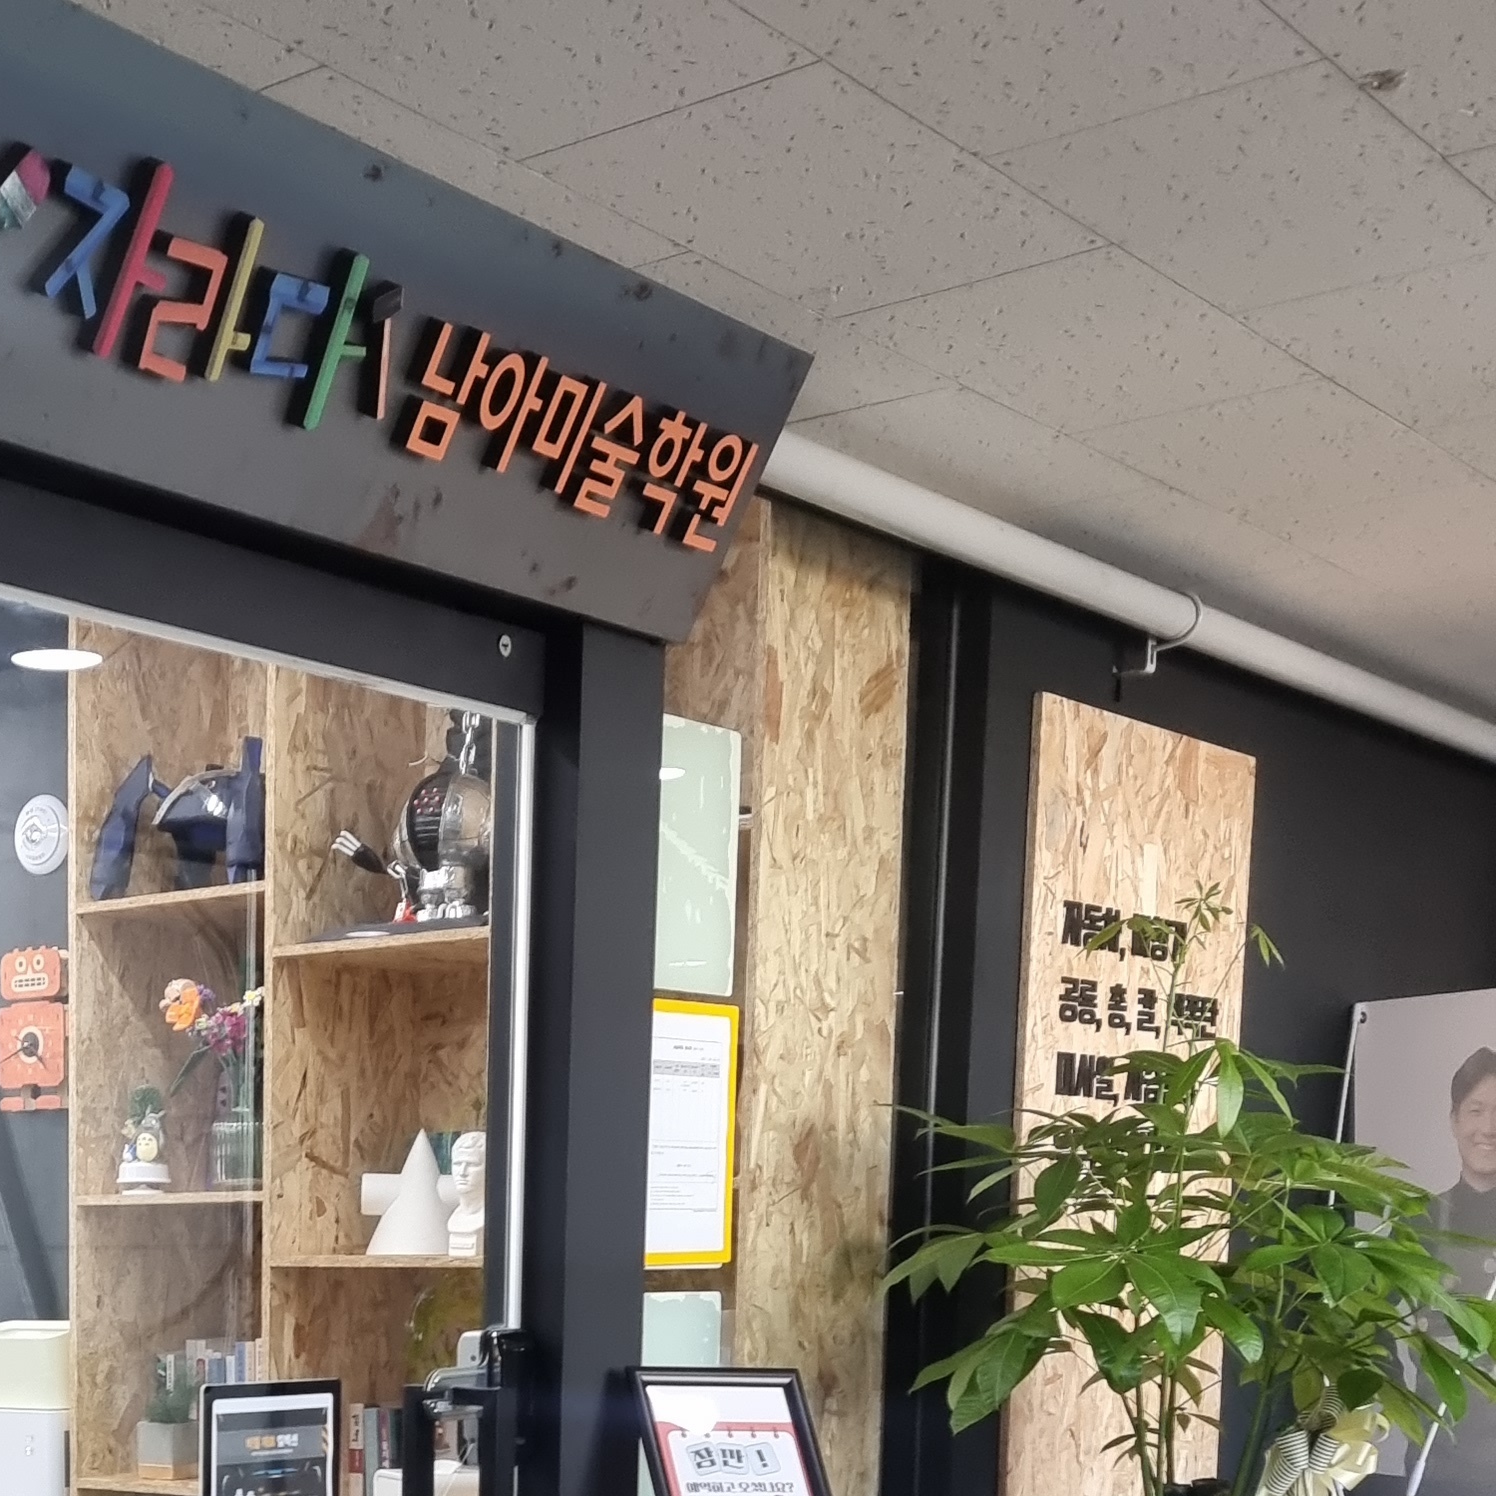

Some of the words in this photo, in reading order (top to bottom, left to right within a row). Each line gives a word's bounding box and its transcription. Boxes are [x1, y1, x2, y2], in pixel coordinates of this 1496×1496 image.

[45, 162, 367, 431] 자라다
[406, 322, 759, 552] 남아미술학원
[1059, 976, 1103, 1033] 공룡,
[1108, 983, 1132, 1036] 총,
[1137, 987, 1162, 1040] 칼,
